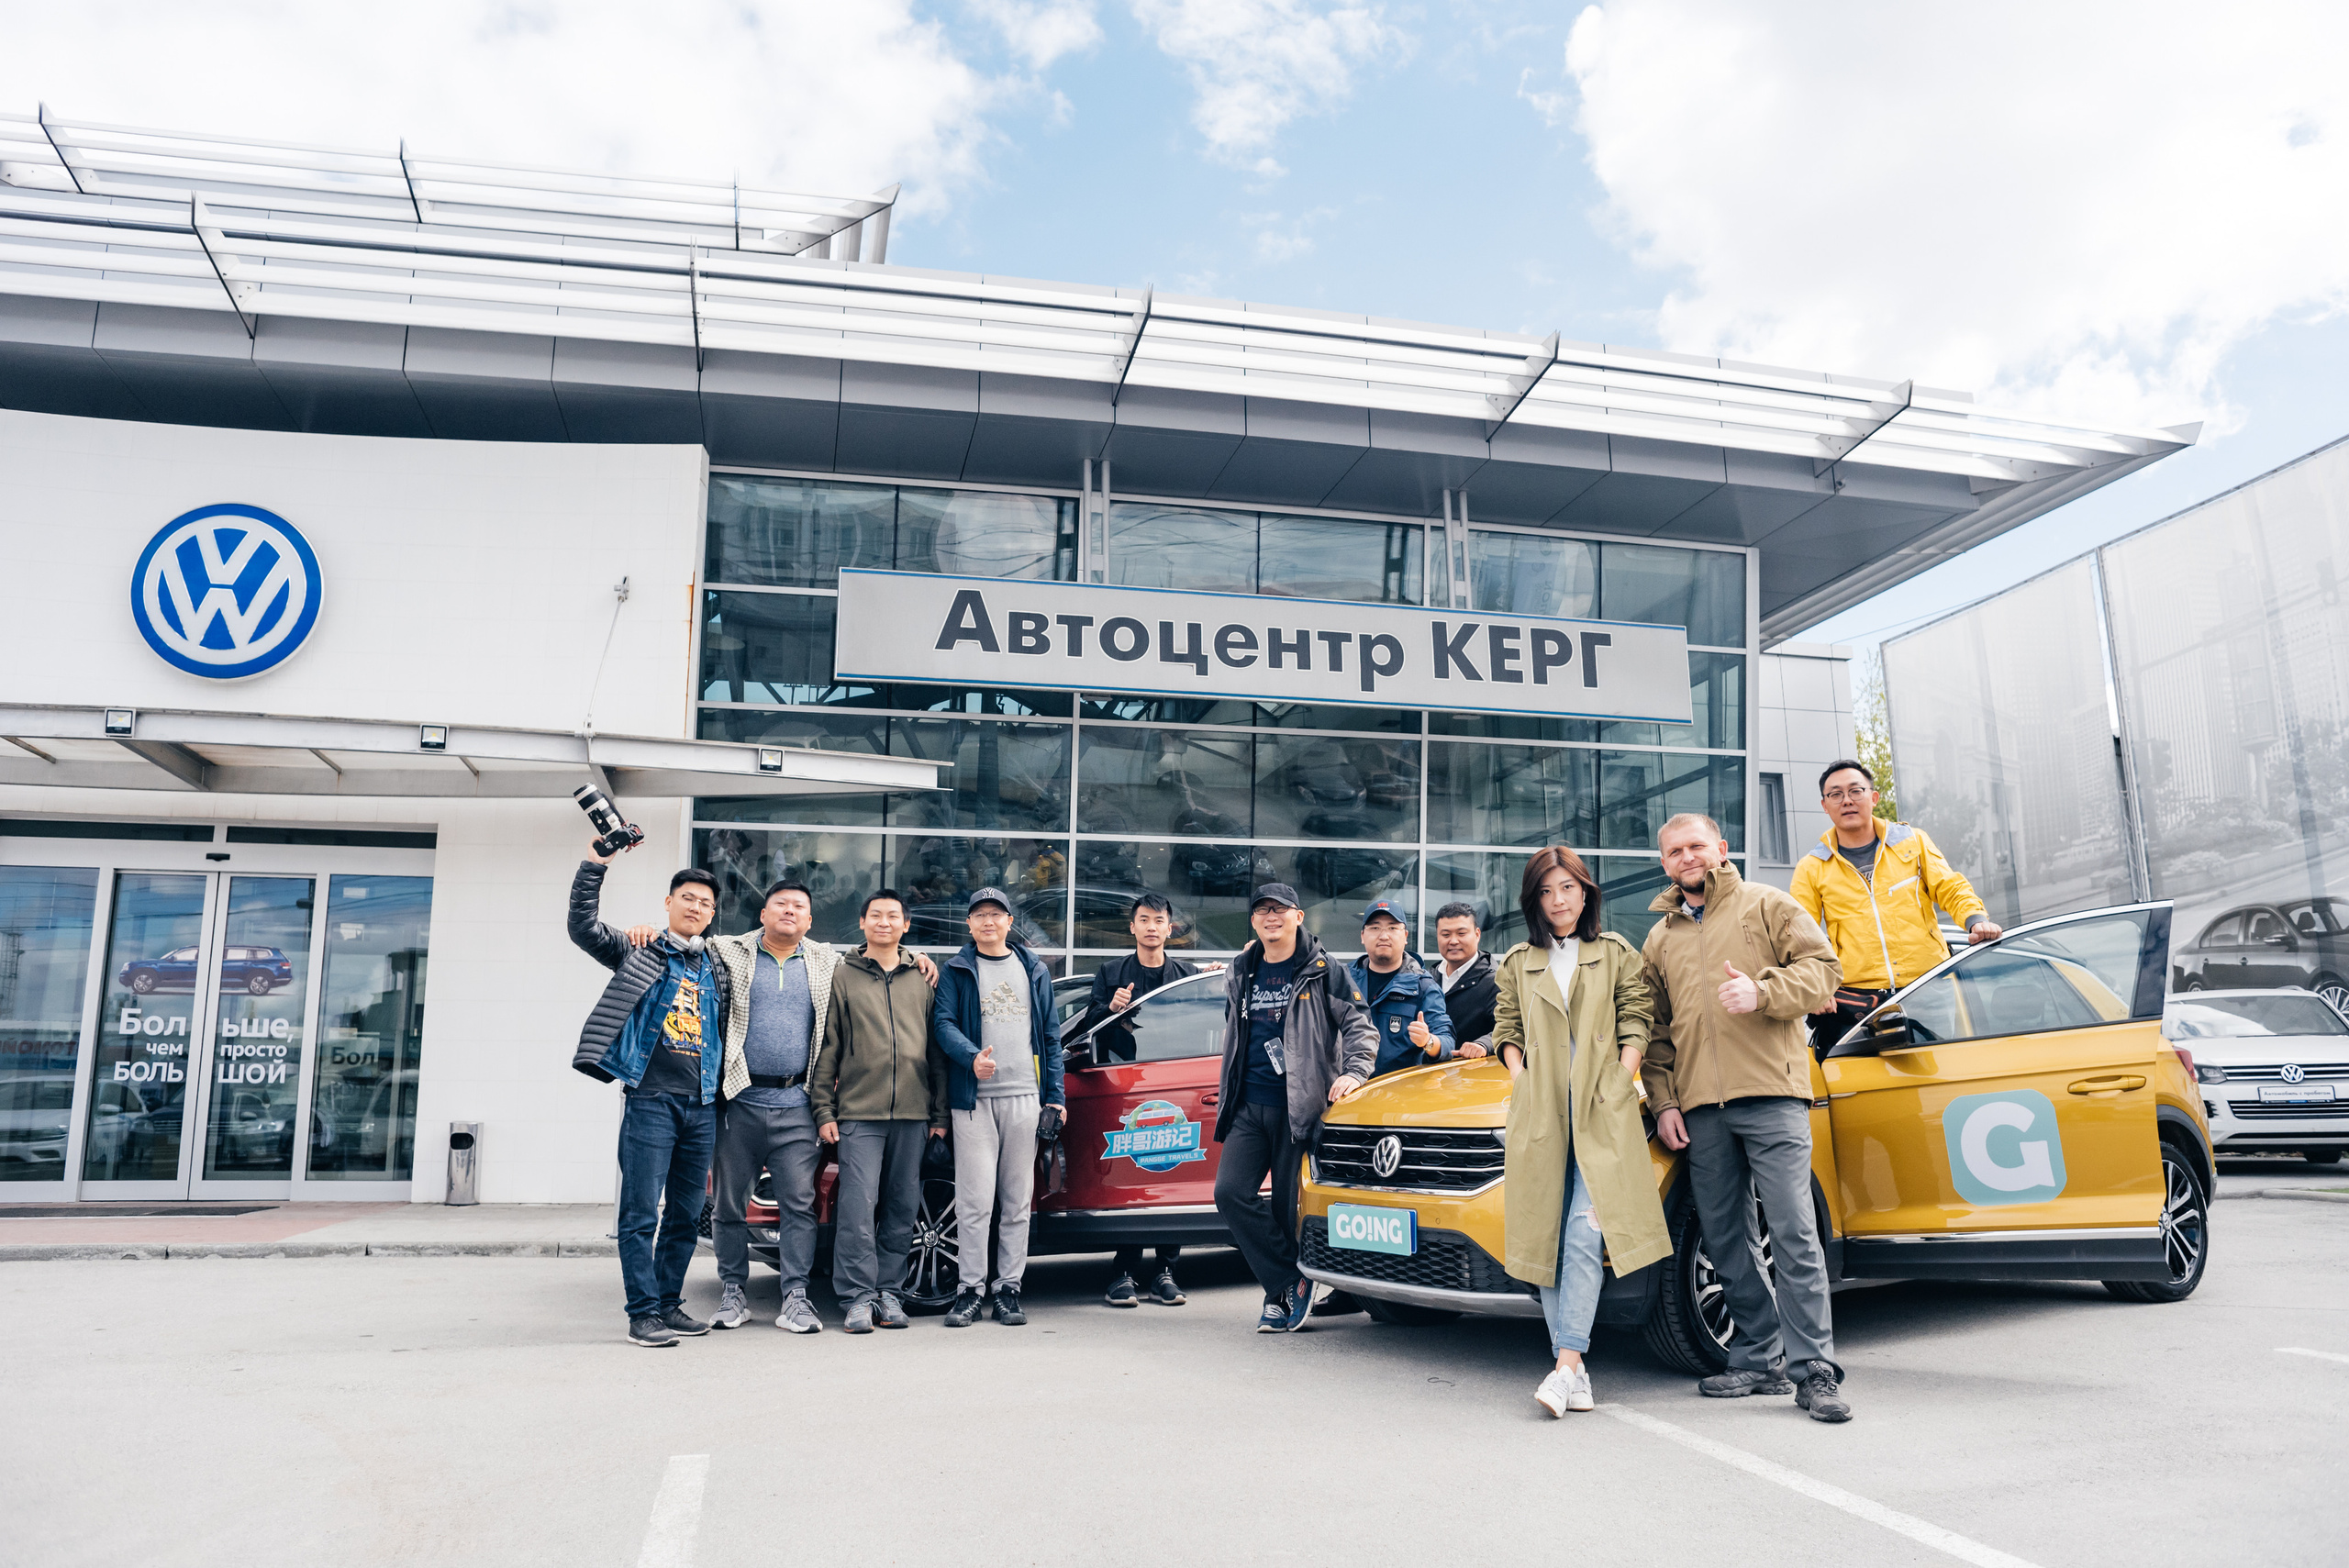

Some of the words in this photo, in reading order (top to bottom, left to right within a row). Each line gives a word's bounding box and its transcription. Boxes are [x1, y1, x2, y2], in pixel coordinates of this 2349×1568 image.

[933, 588, 1405, 693] Автоцентр
[1431, 620, 1613, 689] КЕРГ
[146, 1042, 184, 1056] чем
[219, 1043, 287, 1061] просто
[1112, 1127, 1192, 1154] 胖哥游记
[1960, 1101, 2056, 1192] G
[1168, 1151, 1198, 1162] TRAVELS
